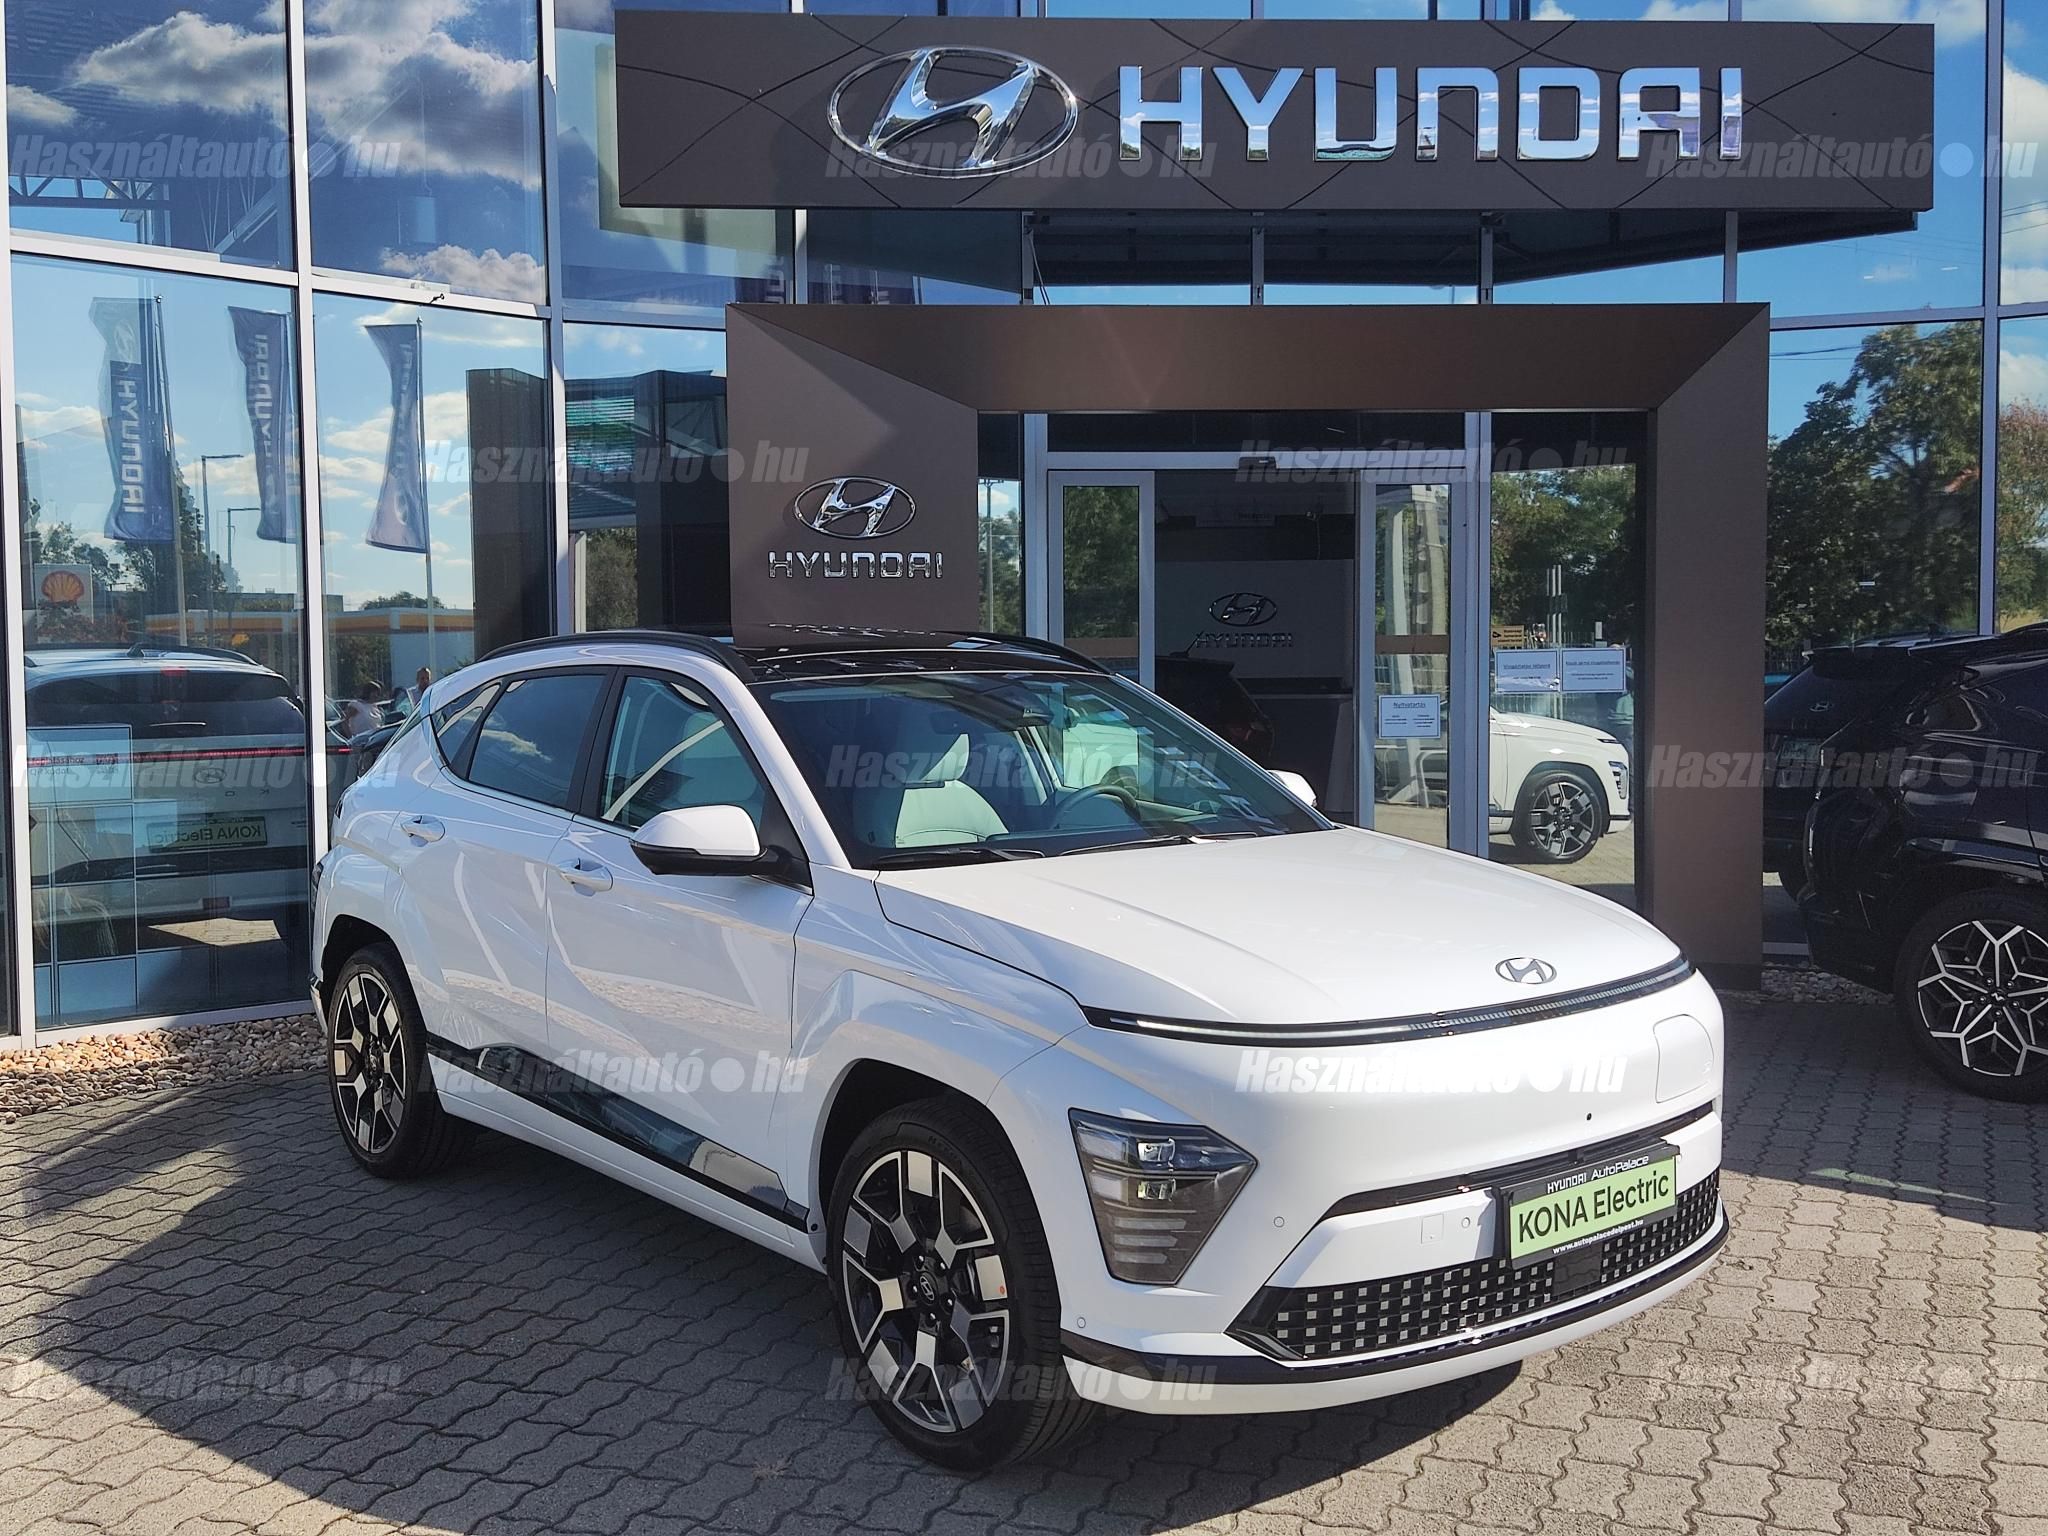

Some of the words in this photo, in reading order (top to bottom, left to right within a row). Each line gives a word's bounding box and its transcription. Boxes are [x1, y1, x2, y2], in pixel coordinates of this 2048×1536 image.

[1118, 65, 1744, 163] HYUNDAI
[117, 380, 145, 513] HYUNDAI
[768, 551, 944, 579] HYUNDAI
[1195, 631, 1294, 648] HYUNDAI
[1547, 1172, 1587, 1194] HYUNDAI
[1591, 1156, 1649, 1180] AutoPalace
[1519, 1196, 1588, 1243] KONA
[1594, 1170, 1669, 1220] Electric
